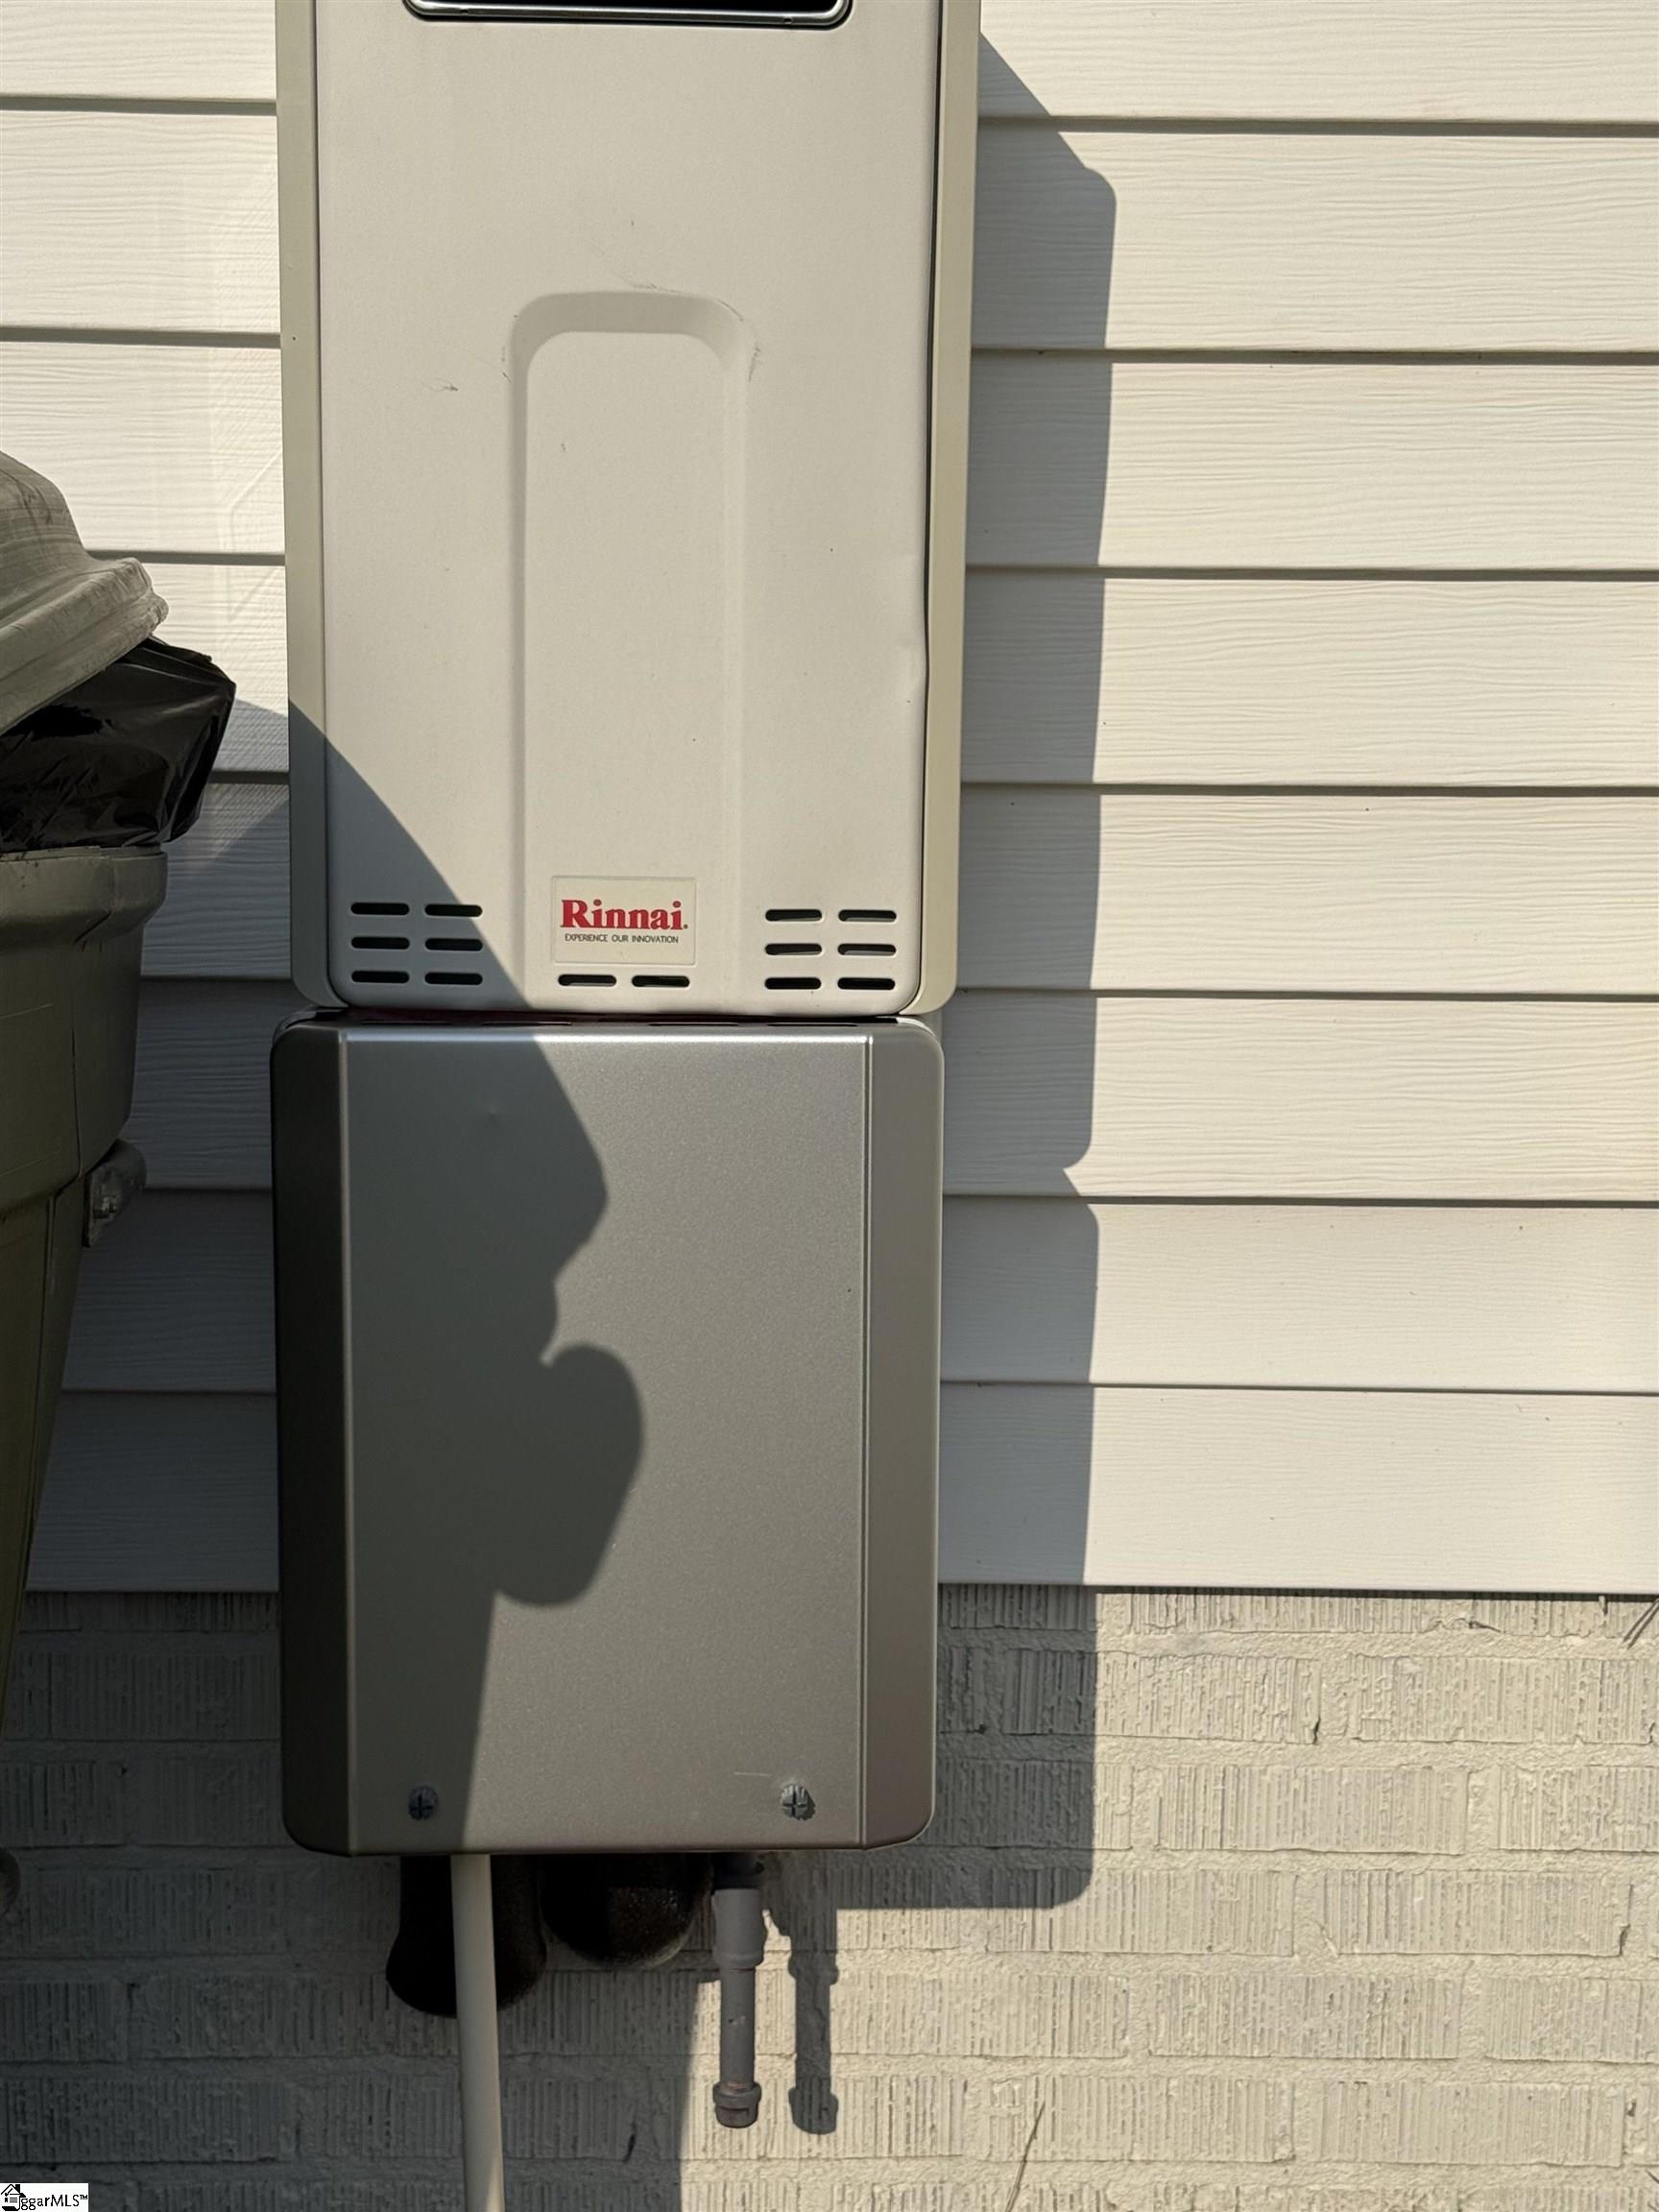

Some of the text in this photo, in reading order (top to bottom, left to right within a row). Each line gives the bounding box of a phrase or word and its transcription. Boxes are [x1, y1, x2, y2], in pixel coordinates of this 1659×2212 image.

[565, 933, 679, 944] EXPERIENCE OUR INNOVATION
